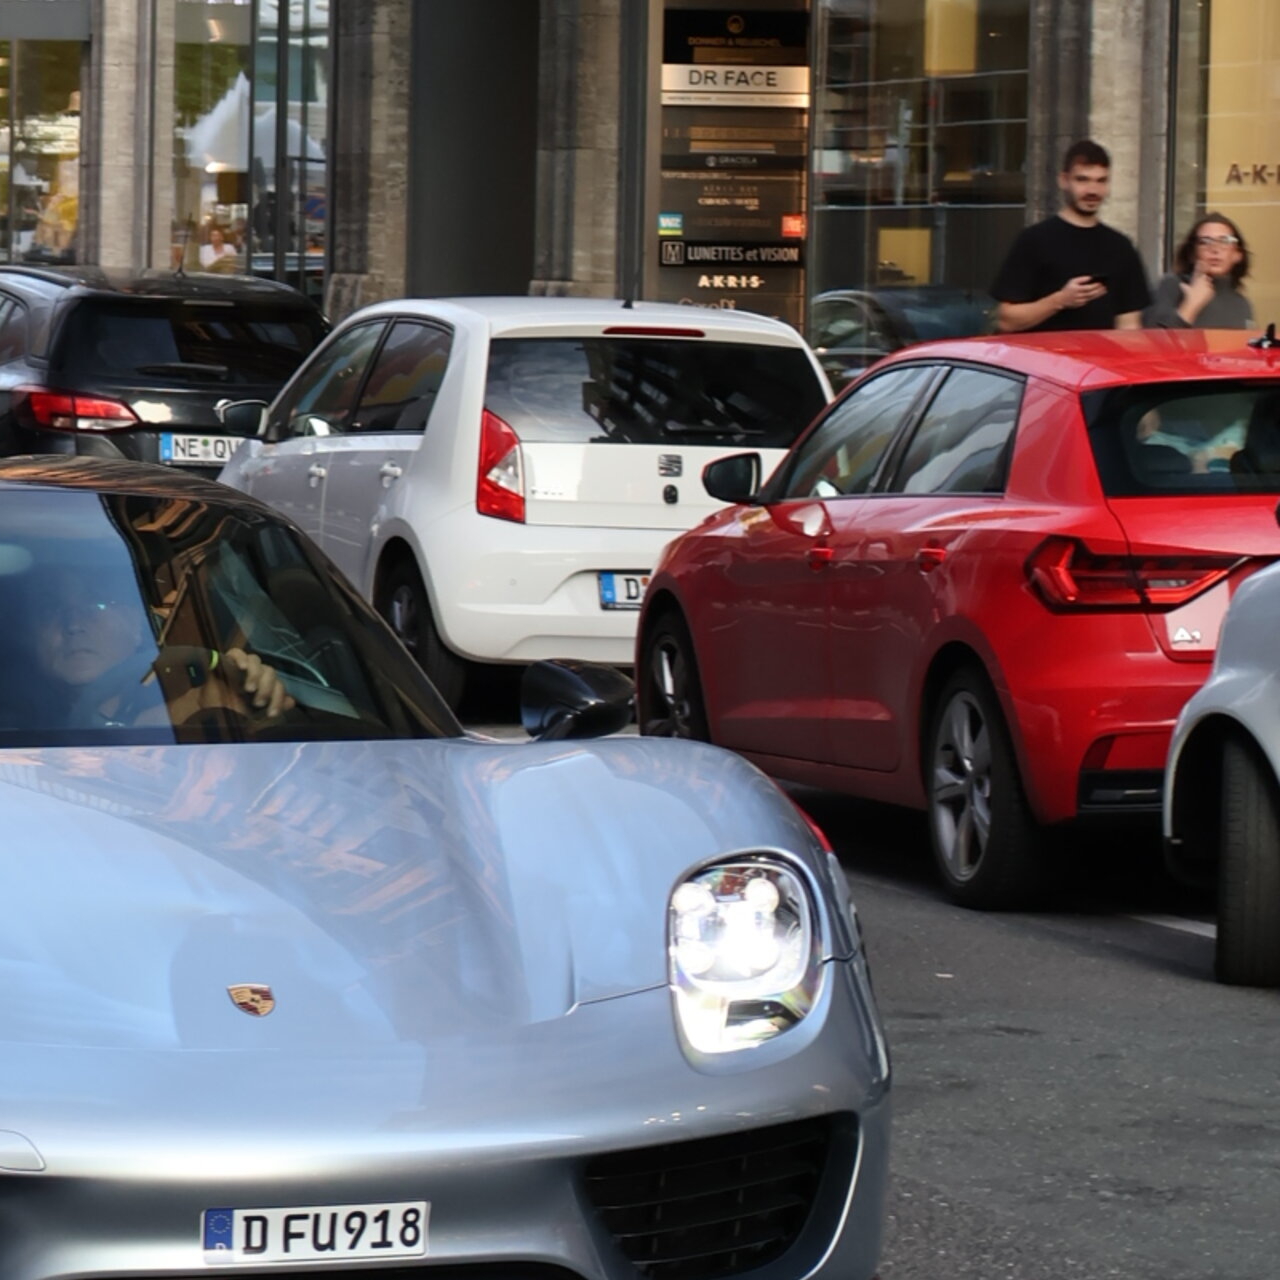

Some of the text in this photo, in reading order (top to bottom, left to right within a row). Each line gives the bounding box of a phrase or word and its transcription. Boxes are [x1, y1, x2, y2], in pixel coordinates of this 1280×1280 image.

[688, 70, 778, 87] DR FACE
[687, 246, 744, 261] LUNETTES
[745, 248, 758, 261] et
[759, 247, 799, 261] VISION
[174, 438, 199, 458] NE
[624, 578, 640, 601] D
[242, 1215, 269, 1255] D
